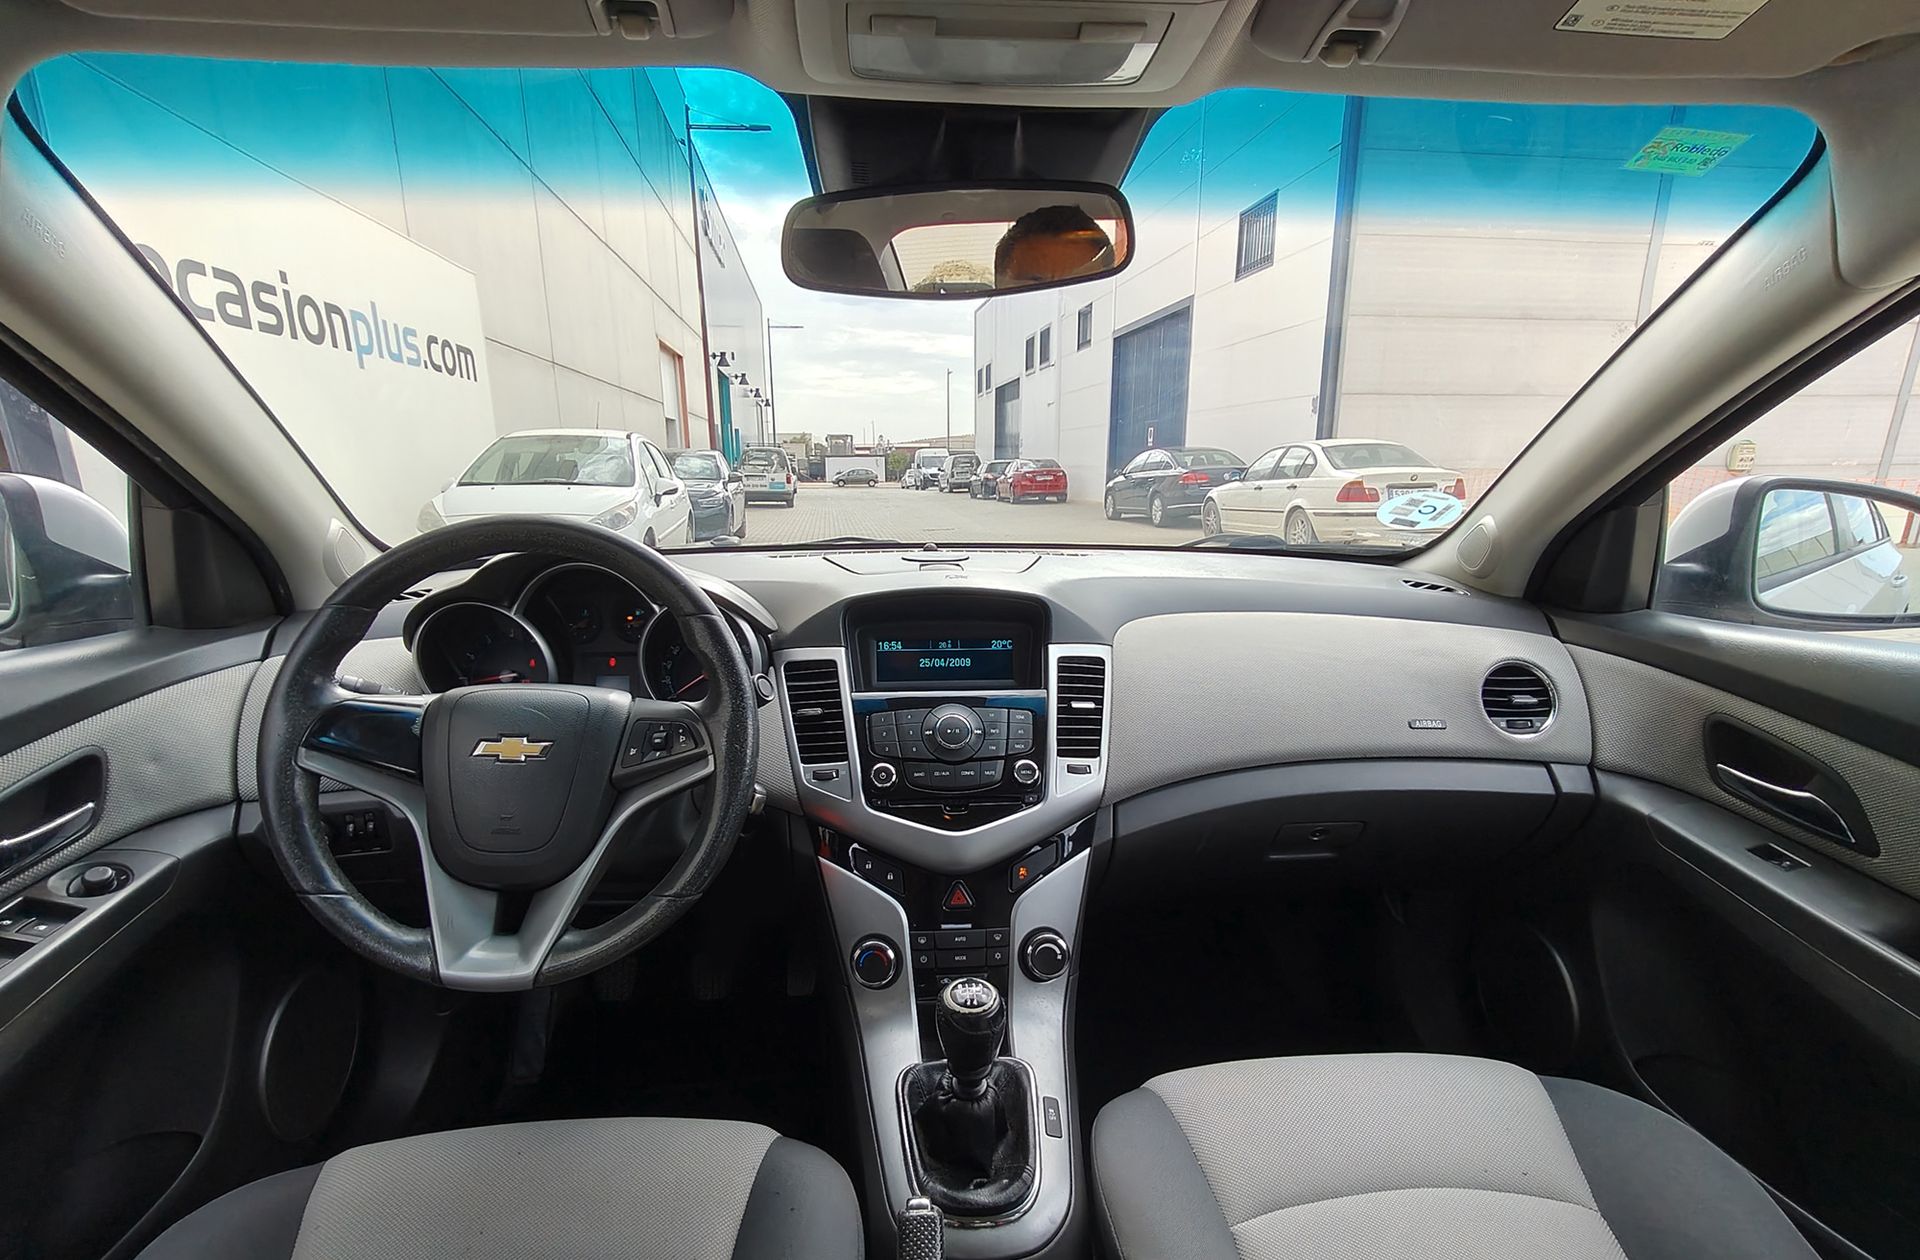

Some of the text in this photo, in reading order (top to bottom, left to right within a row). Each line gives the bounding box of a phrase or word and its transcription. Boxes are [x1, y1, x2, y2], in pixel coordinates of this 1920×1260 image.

[1671, 142, 1732, 158] Robledo
[878, 641, 902, 650] 16:54
[991, 640, 1013, 650] 20°C
[919, 658, 971, 668] 25/04/2009
[1416, 720, 1442, 728] AIRBAG
